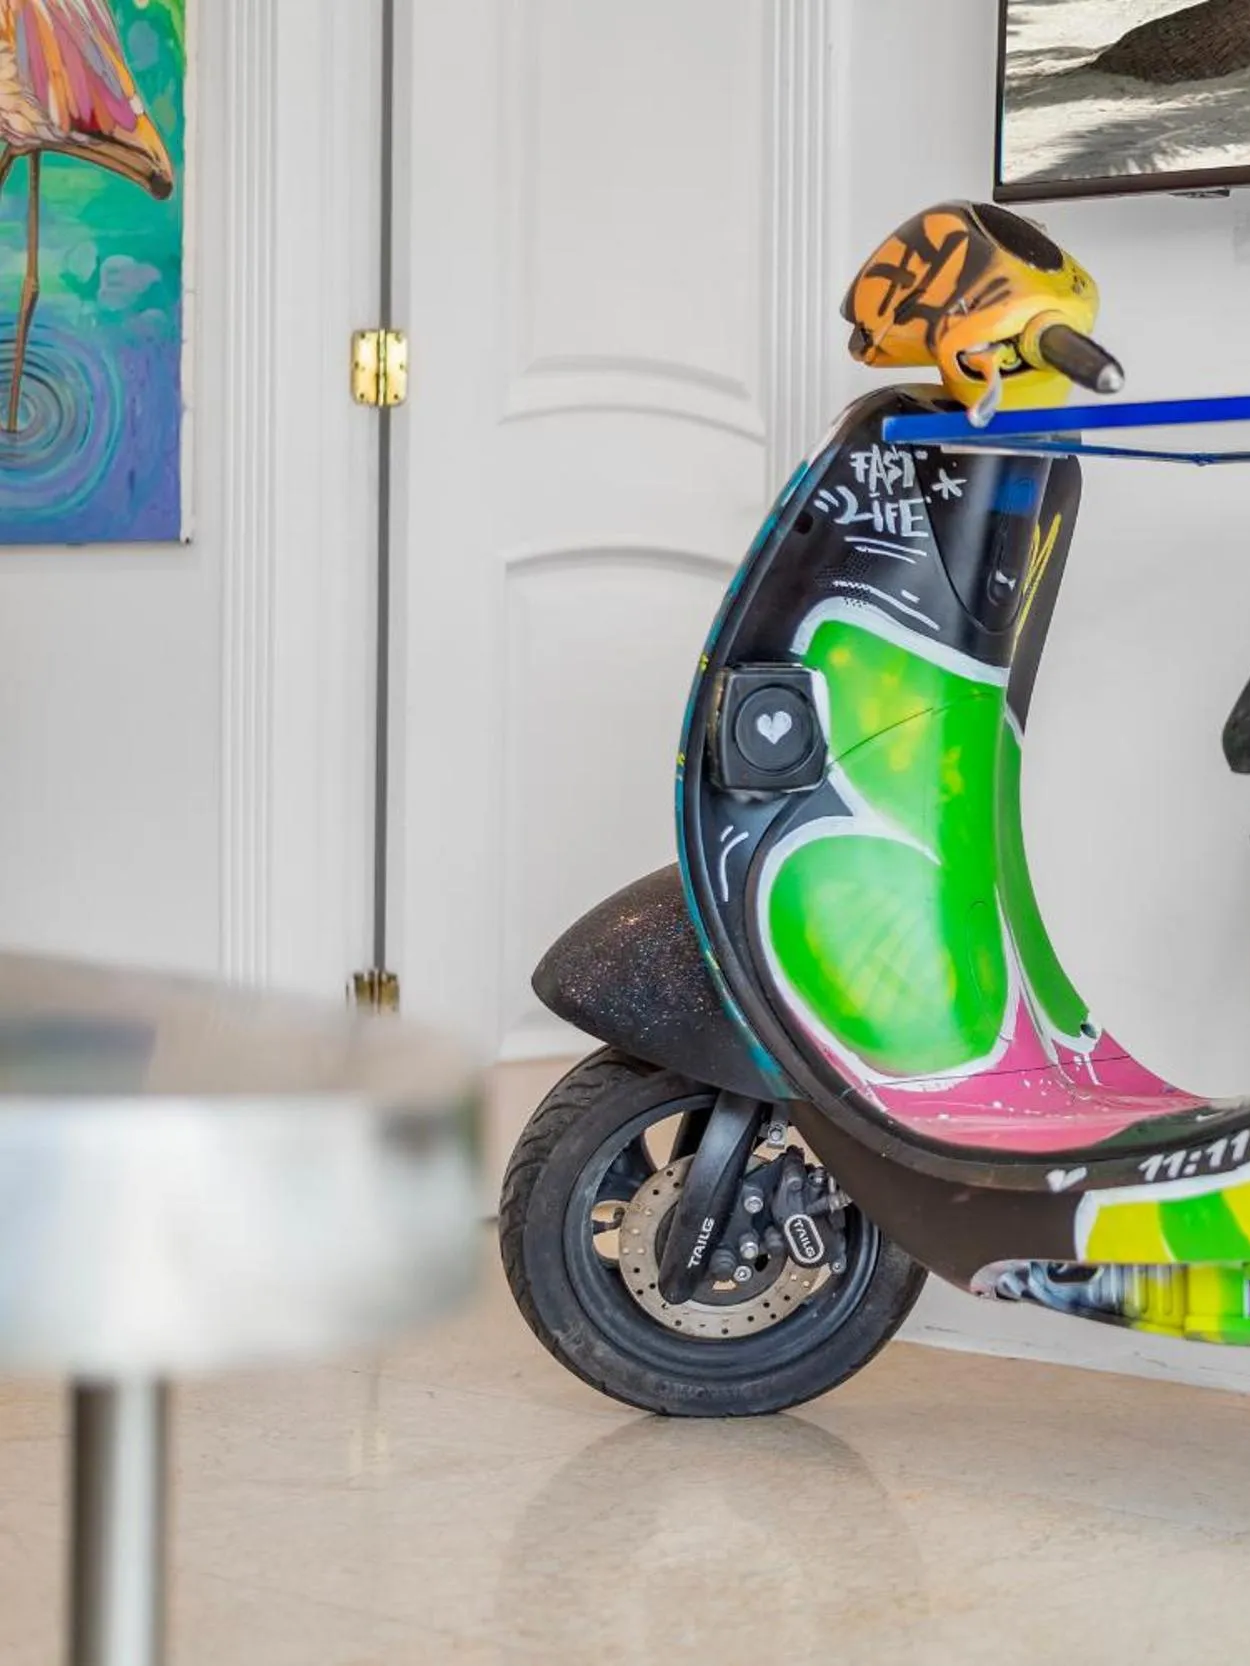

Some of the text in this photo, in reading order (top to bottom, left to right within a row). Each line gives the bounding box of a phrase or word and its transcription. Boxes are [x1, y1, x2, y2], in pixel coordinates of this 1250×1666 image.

[850, 444, 915, 495] FAST
[833, 486, 929, 537] LIFE
[1138, 1129, 1250, 1182] 11:11
[687, 1217, 715, 1268] TAILG
[793, 1219, 816, 1258] TAILG
